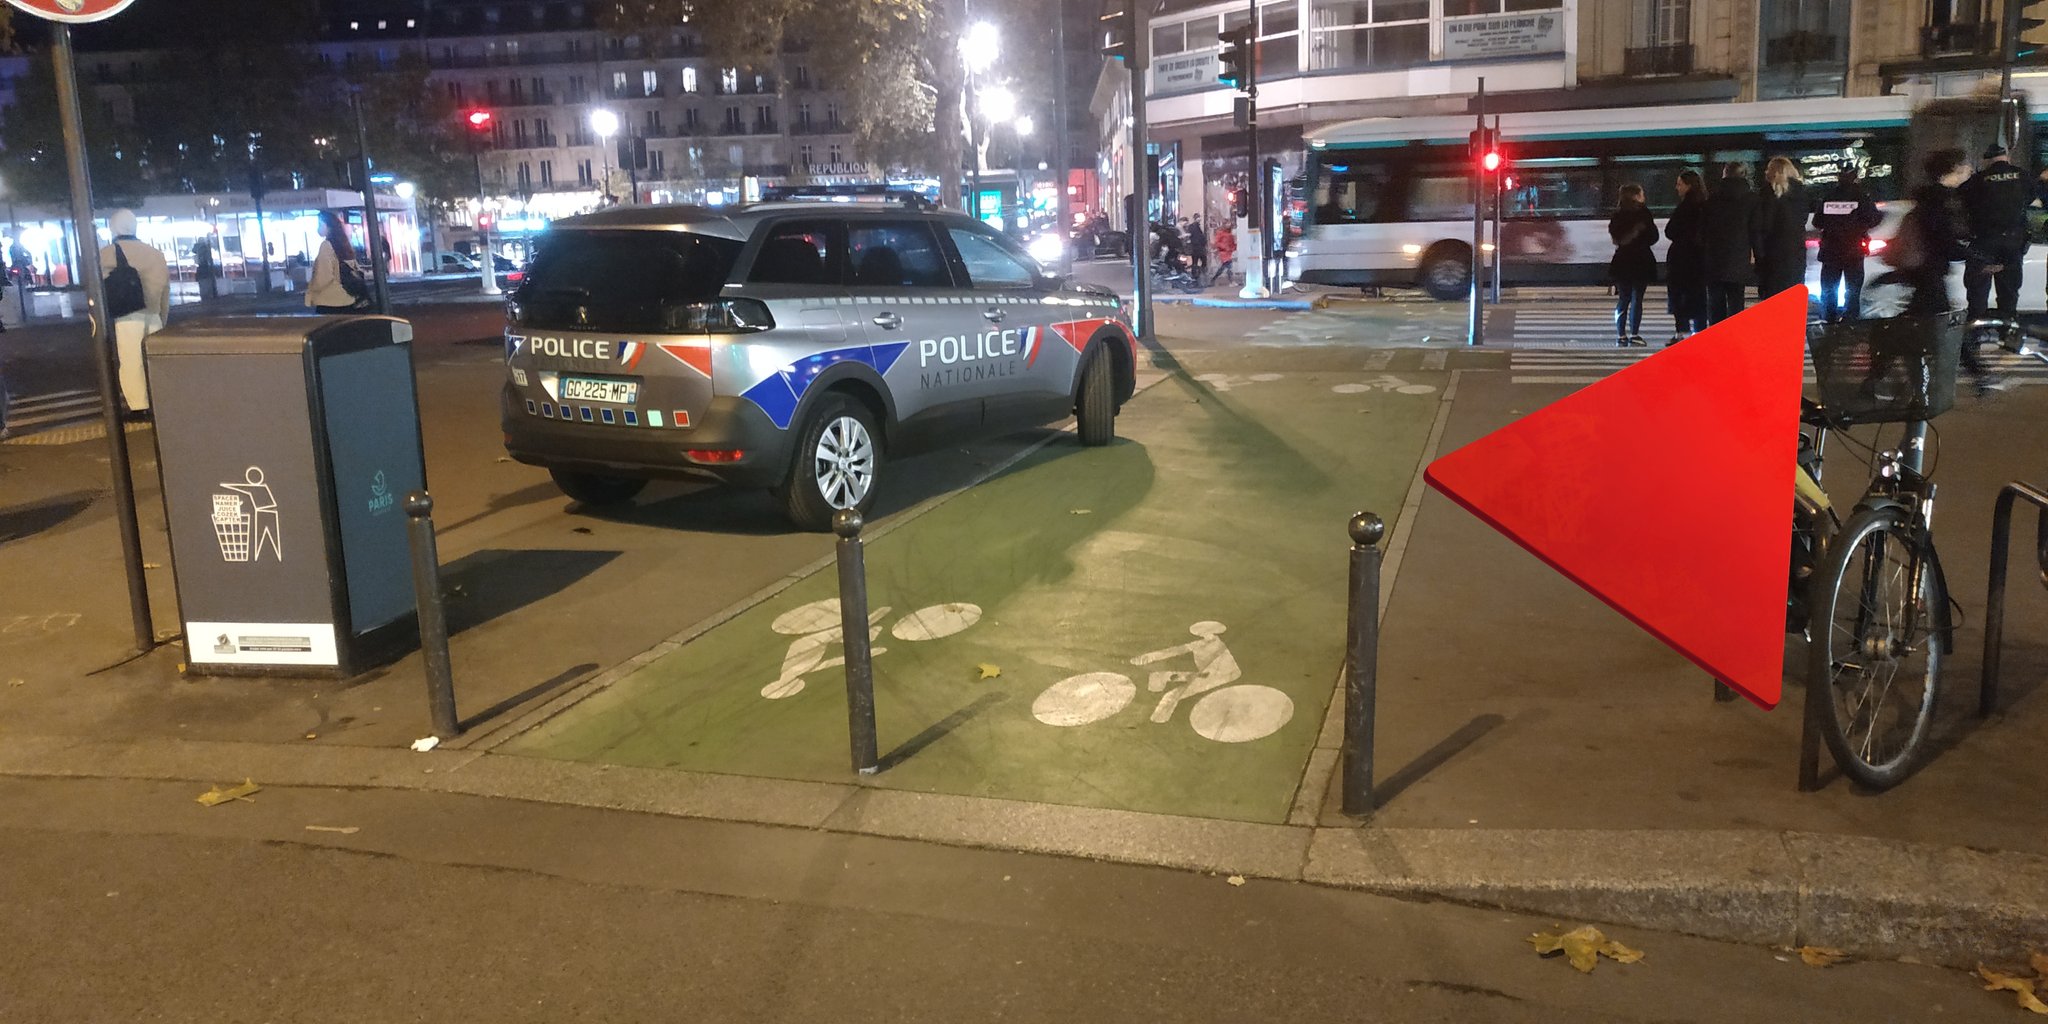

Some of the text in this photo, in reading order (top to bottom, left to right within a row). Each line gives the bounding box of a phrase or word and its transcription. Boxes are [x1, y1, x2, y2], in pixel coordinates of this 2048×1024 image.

[809, 161, 872, 174] REPUBLIQU
[1984, 172, 2020, 181] POLICE
[531, 336, 610, 360] POLICE
[920, 329, 1016, 368] POLICE
[920, 361, 1016, 390] NATIONALE
[368, 494, 393, 512] PARIS
